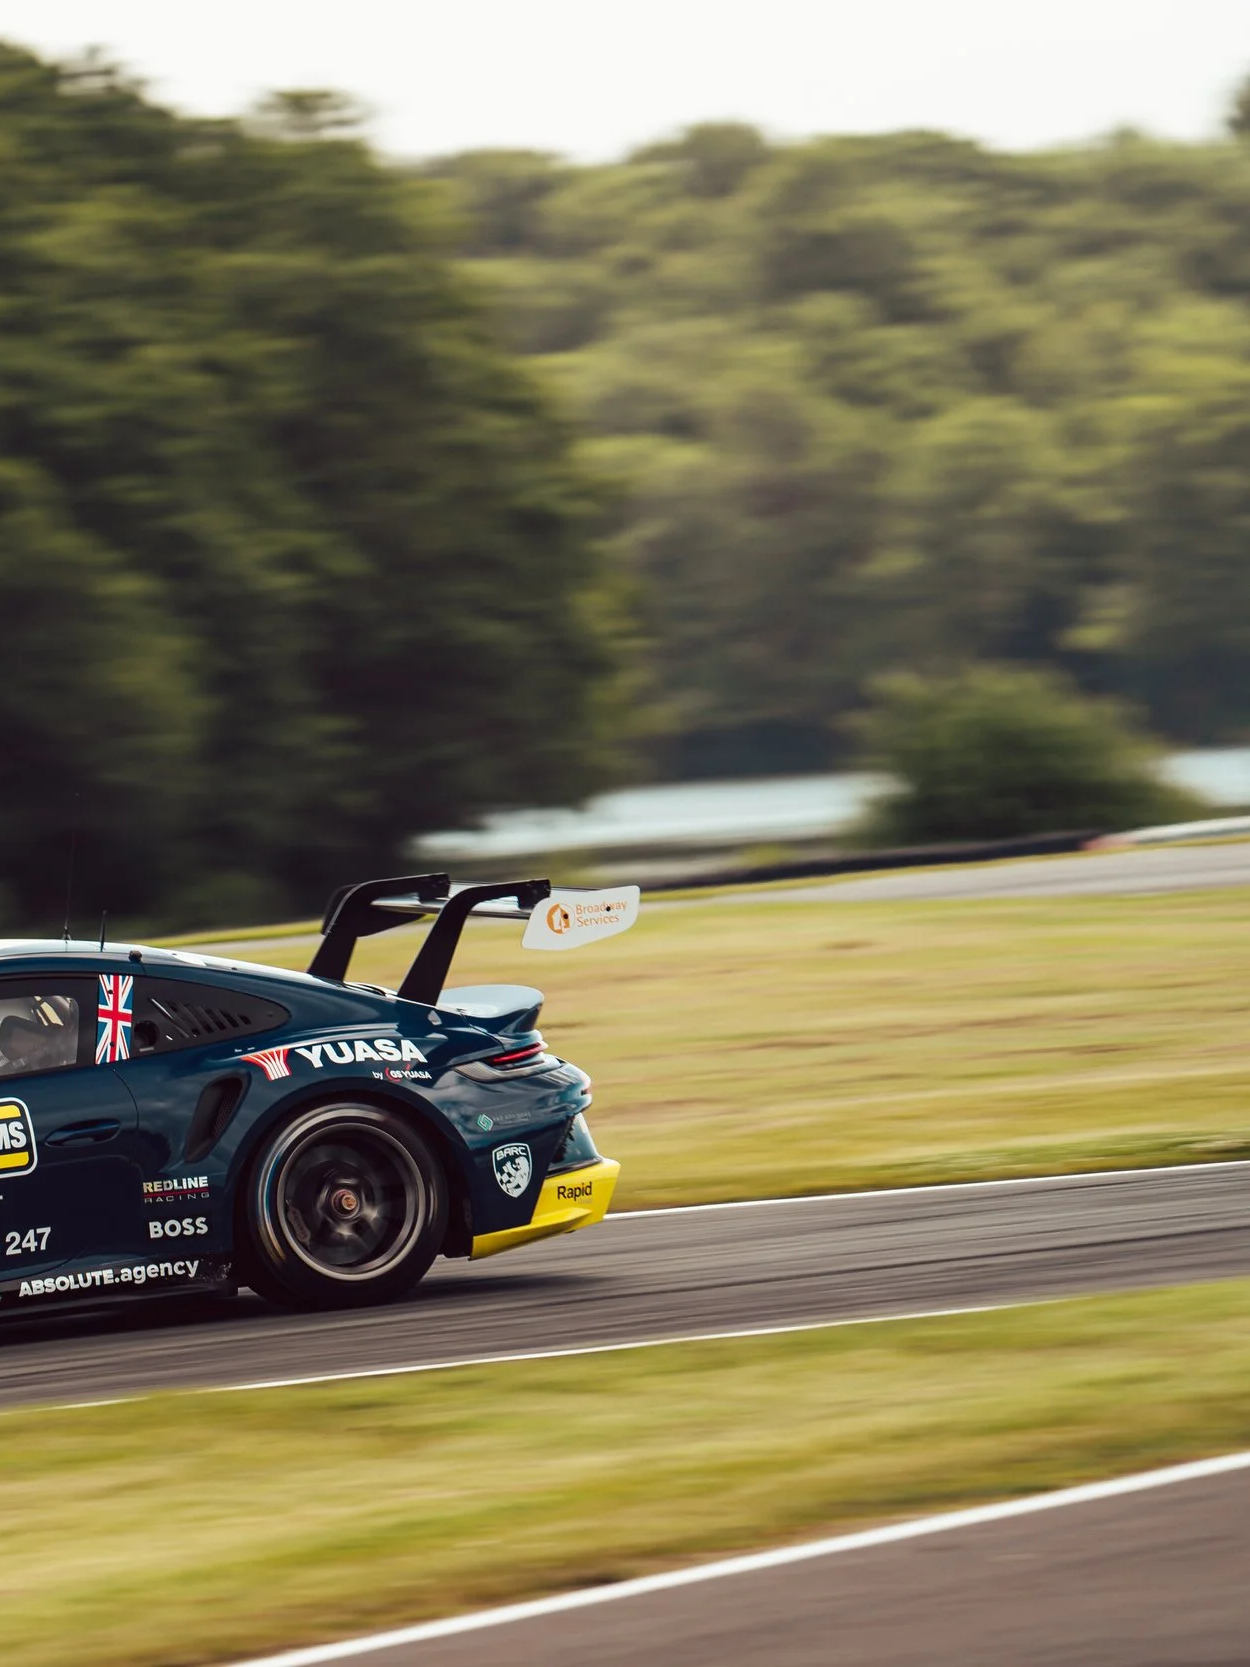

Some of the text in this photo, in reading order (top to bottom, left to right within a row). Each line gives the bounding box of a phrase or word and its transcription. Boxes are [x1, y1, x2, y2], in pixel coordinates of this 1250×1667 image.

[575, 901, 627, 915] Broadway
[576, 914, 620, 927] Services
[294, 1039, 428, 1069] YUASA
[371, 1071, 384, 1080] by
[496, 1147, 527, 1161] BARC
[143, 1176, 209, 1193] REDLINE
[557, 1181, 592, 1201] Rapid
[144, 1192, 210, 1203] RACING
[148, 1217, 209, 1239] BOSS
[5, 1226, 51, 1256] 247
[18, 1260, 200, 1298] ABSOLUTE.agency
